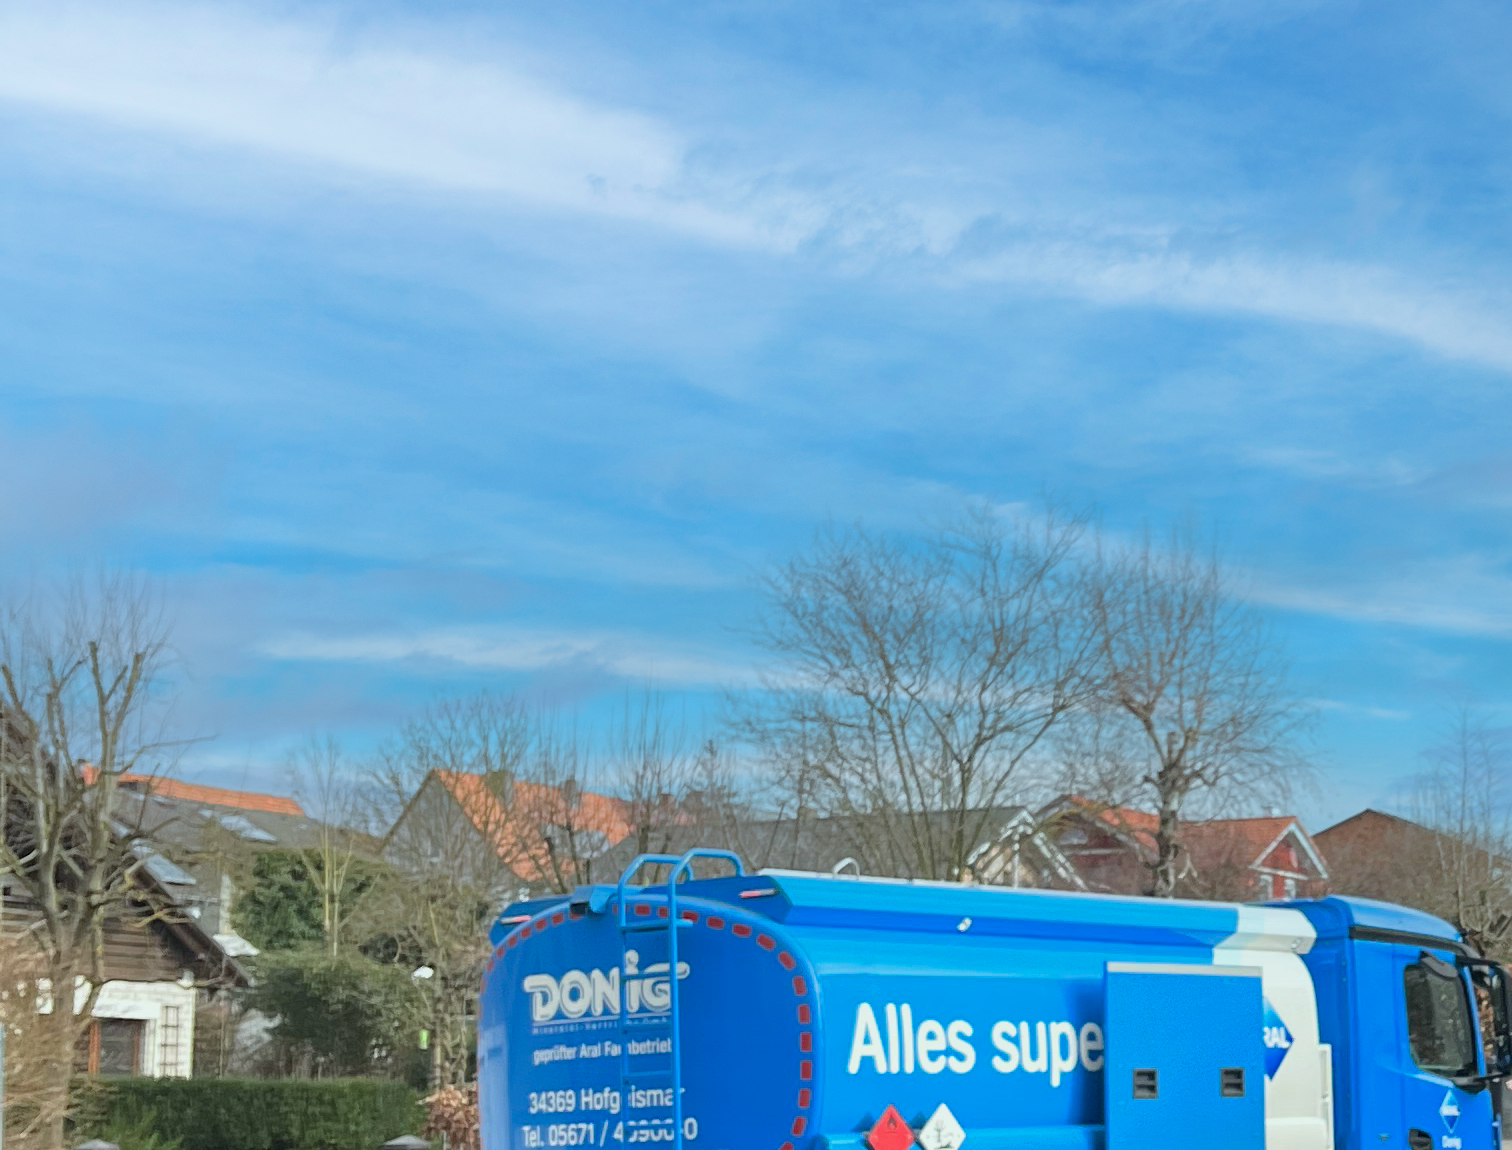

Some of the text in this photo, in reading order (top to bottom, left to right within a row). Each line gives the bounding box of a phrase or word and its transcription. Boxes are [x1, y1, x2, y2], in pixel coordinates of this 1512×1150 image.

[579, 1041, 601, 1059] Aral
[847, 1001, 1104, 1087] Alles supe
[528, 1085, 685, 1114] 34369 Hofgisma
[522, 1125, 545, 1148] Tel.
[548, 1123, 595, 1147] 05671
